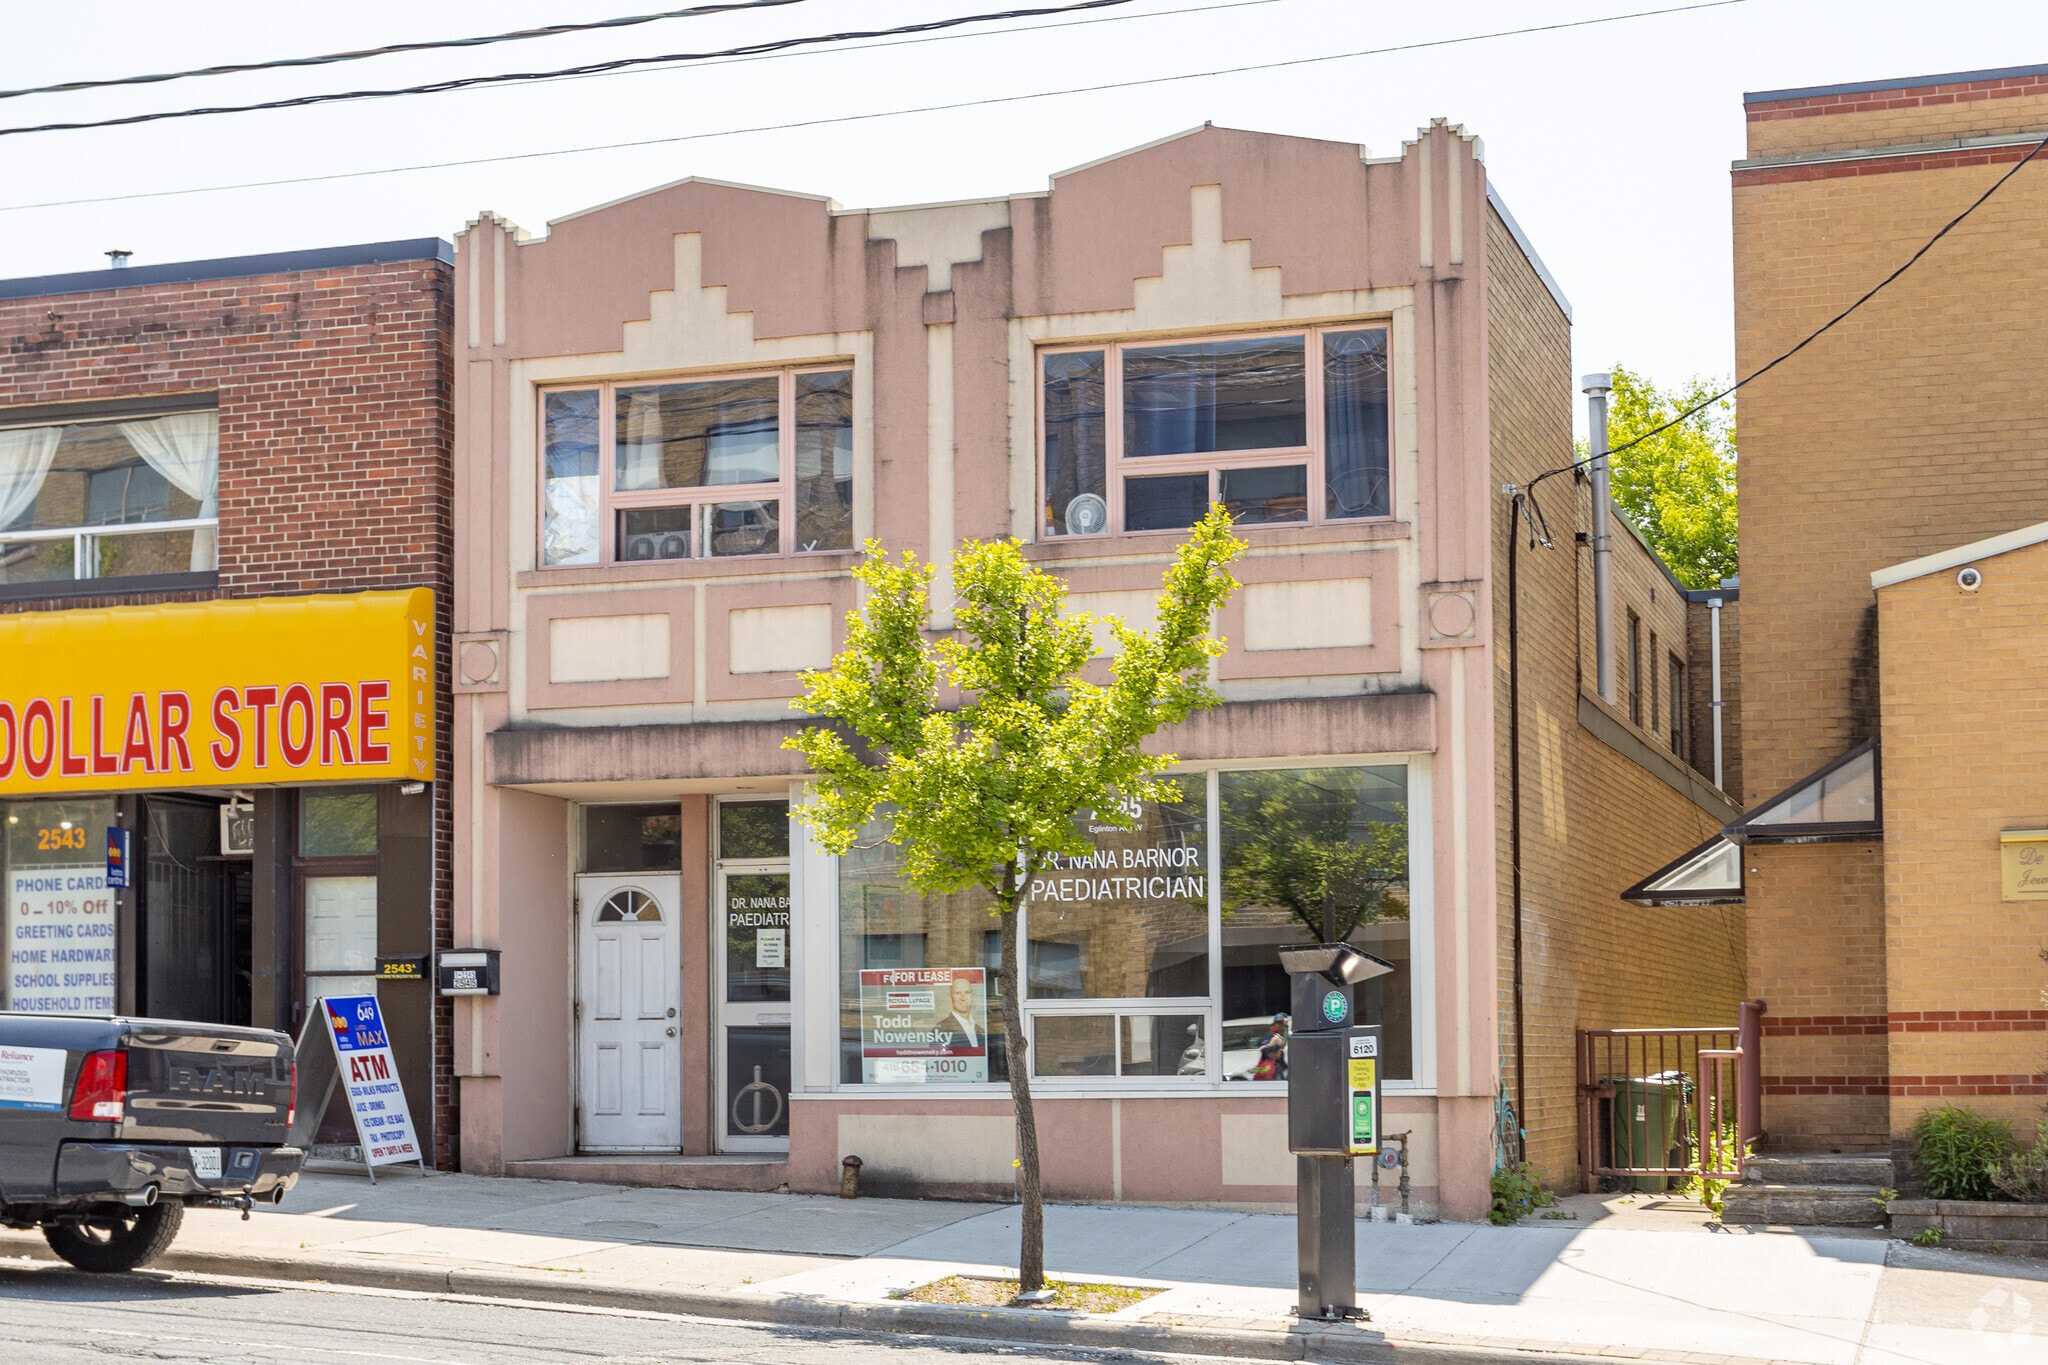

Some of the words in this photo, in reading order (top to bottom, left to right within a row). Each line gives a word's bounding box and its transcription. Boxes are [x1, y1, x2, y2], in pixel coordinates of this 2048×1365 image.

[412, 619, 428, 774] VARIETY
[210, 680, 391, 772] STORE
[38, 827, 86, 850] 2543
[1069, 849, 1118, 869] NANA
[1123, 847, 1199, 868] BARNOR
[16, 879, 62, 892] PHONE
[1030, 876, 1203, 901] PAEDIATRICIAN
[48, 900, 78, 915] 10%
[83, 900, 108, 915] Off
[731, 897, 749, 909] DR.
[750, 897, 778, 909] NANA
[16, 924, 73, 939] GREETING
[77, 923, 114, 938] CARDS
[12, 949, 47, 963] HOME
[15, 974, 60, 988] SCHOOL
[895, 971, 915, 983] FOR
[918, 970, 951, 982] LEASE
[12, 997, 81, 1011] HOUSEHOLD
[357, 1003, 374, 1021] 649
[873, 1015, 912, 1029] Todd
[356, 1030, 385, 1047] MAX
[873, 1029, 953, 1046] Nowensky
[2, 1051, 34, 1061] Reliance
[1353, 1045, 1374, 1054] 6120
[350, 1054, 391, 1082] ATM
[169, 1067, 264, 1095] RAM
